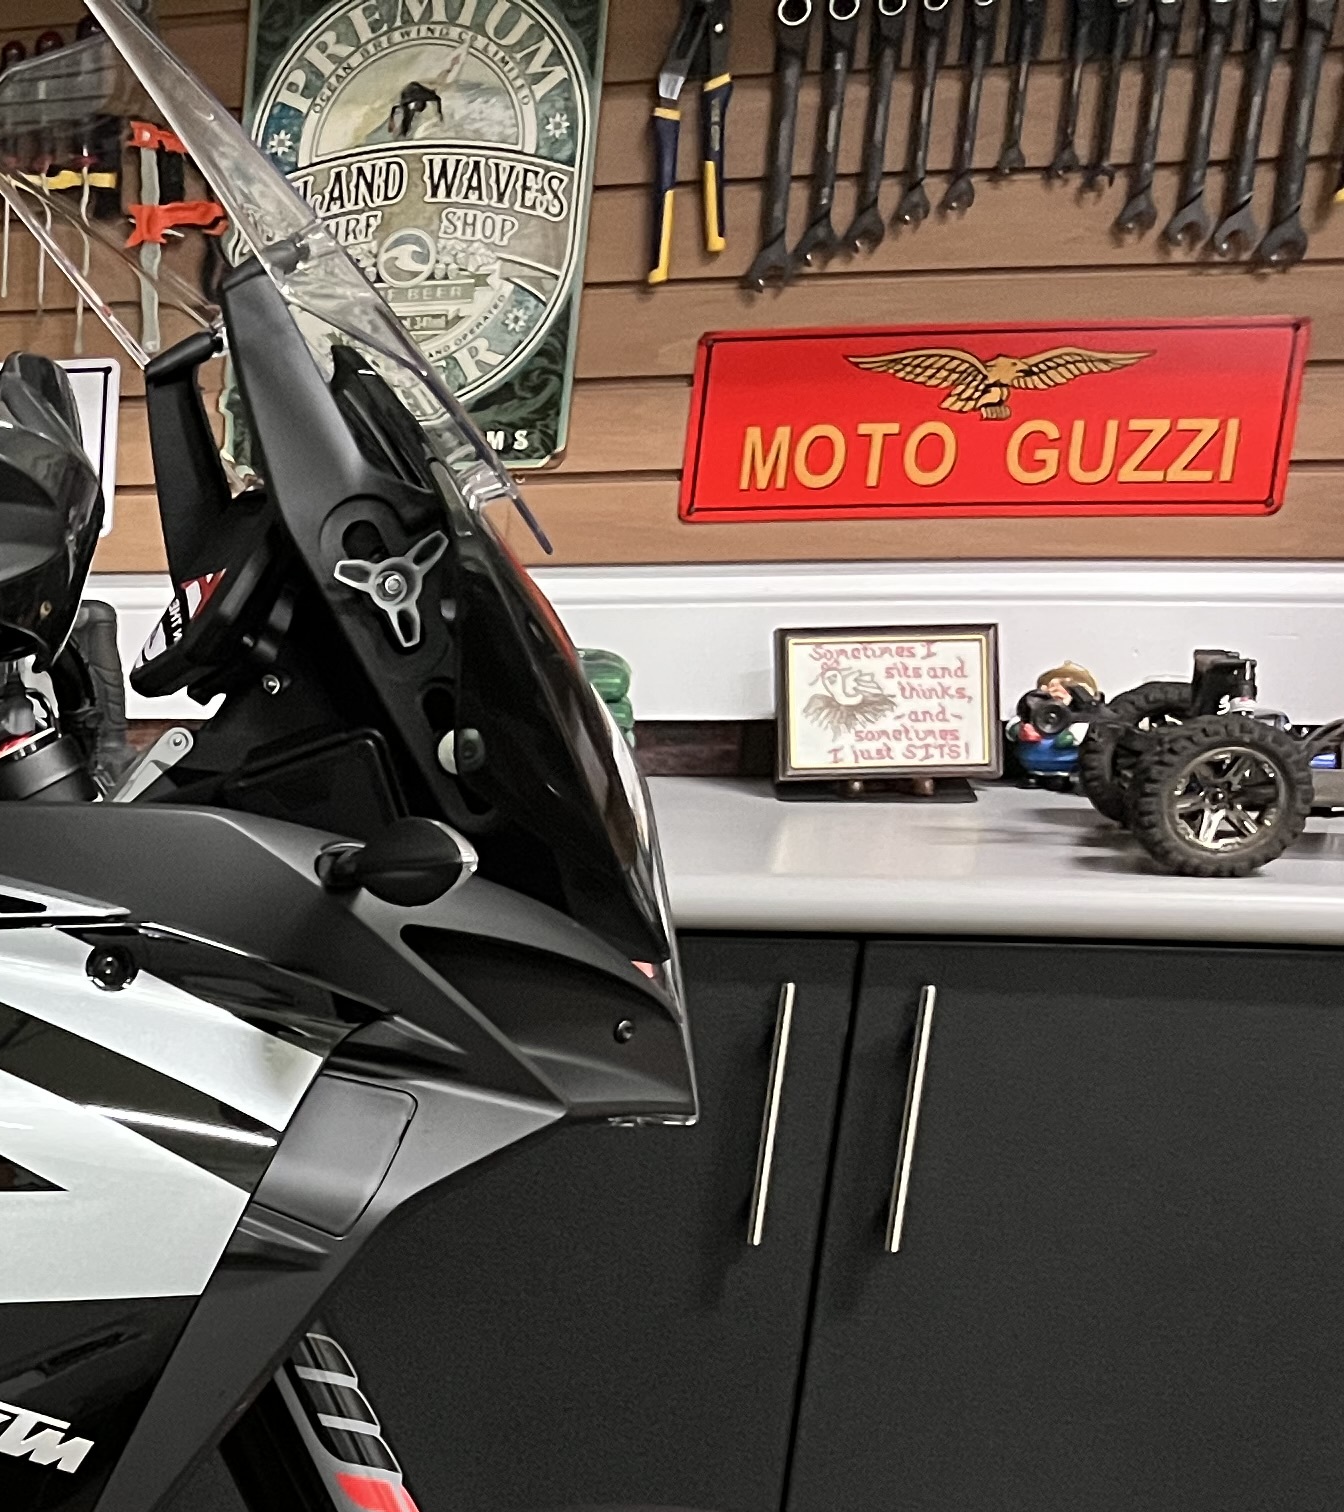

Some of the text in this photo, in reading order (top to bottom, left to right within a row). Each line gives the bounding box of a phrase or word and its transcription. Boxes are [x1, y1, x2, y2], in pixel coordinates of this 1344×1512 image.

[275, 0, 569, 114] PREMIUM
[296, 155, 570, 221] LAND WAVES
[438, 207, 519, 246] SHOP
[407, 286, 462, 300] BEER
[739, 417, 1240, 491] MOTO GUZZI
[808, 641, 939, 662] Sometimes I
[884, 656, 969, 680] sits and
[897, 680, 974, 704] thinks,
[853, 724, 961, 743] sometimes
[827, 742, 972, 764] I just SITS!
